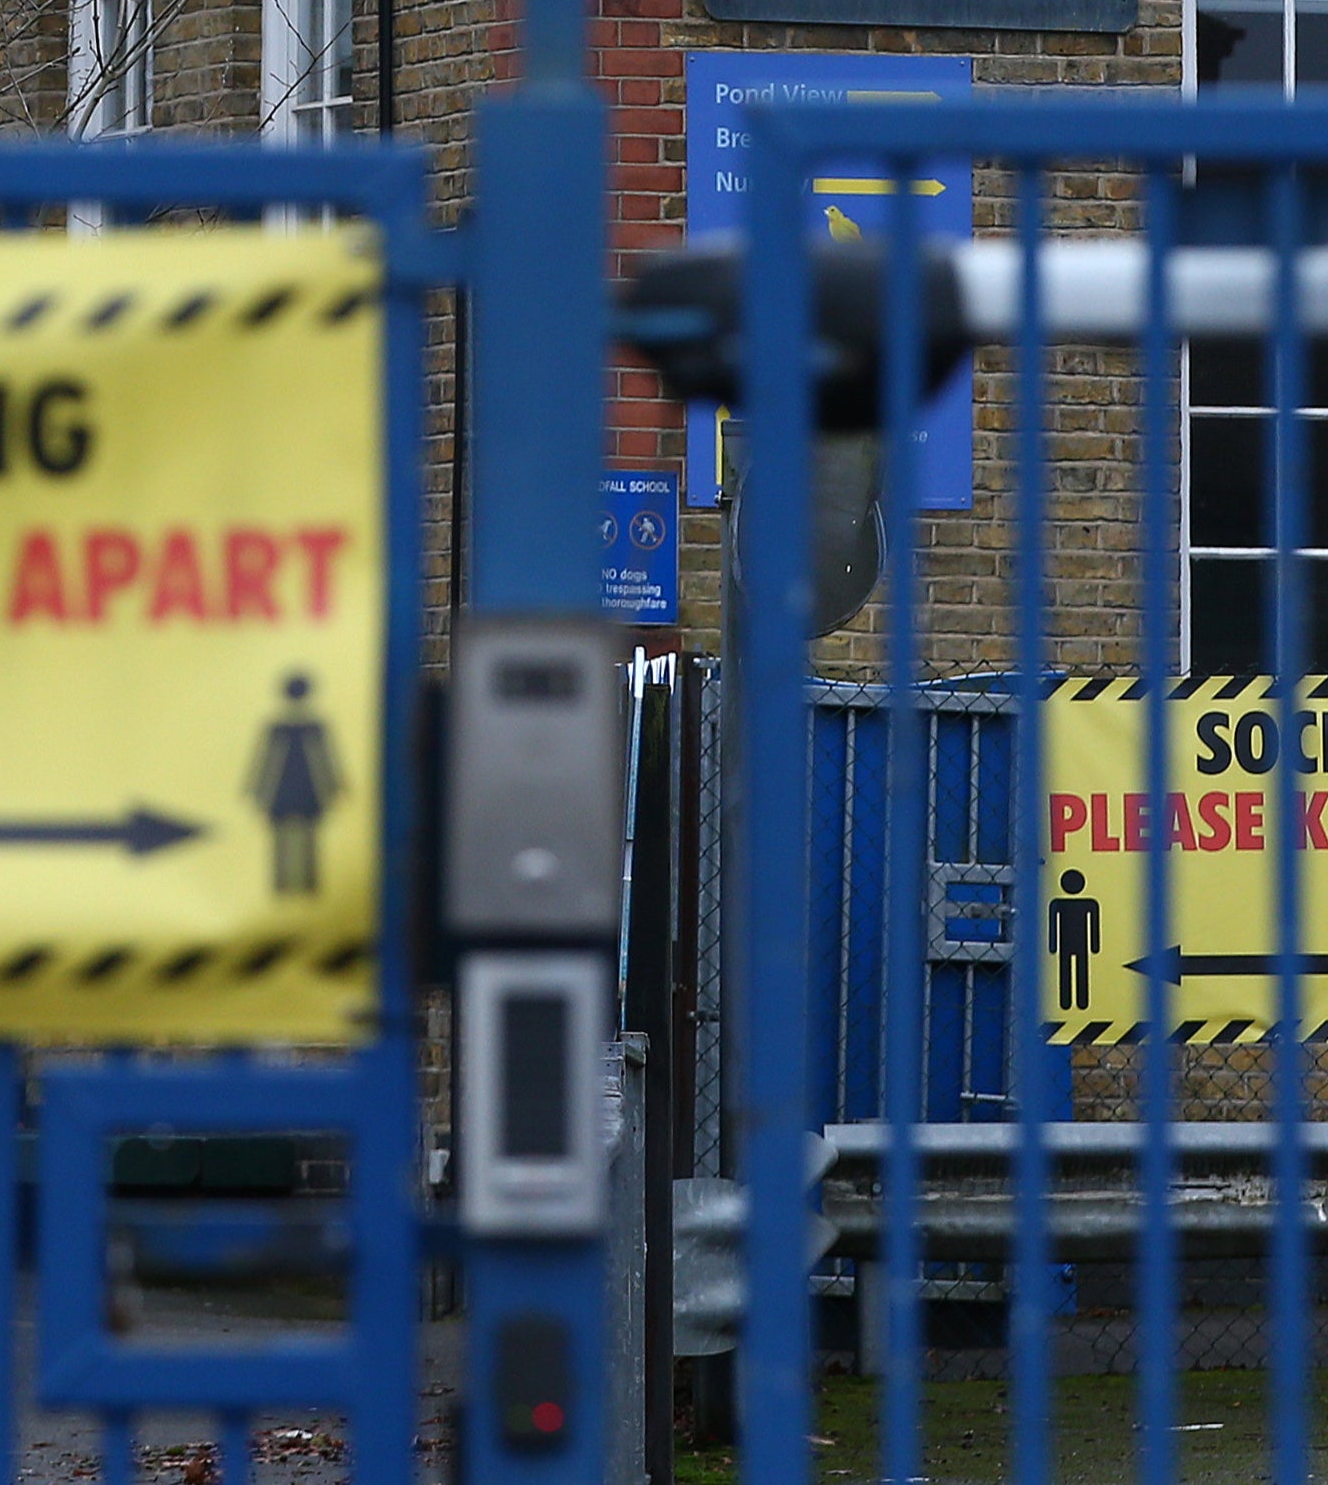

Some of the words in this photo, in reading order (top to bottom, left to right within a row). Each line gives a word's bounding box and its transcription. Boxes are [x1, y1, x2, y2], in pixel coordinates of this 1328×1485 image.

[715, 83, 775, 105] Pond
[782, 83, 843, 105] View
[629, 480, 671, 494] SCHOOL
[9, 526, 350, 625] APART
[620, 568, 648, 582] dogs
[606, 583, 662, 597] trespassing
[602, 596, 668, 612] thoroughfare
[1049, 791, 1265, 853] PLEASE
